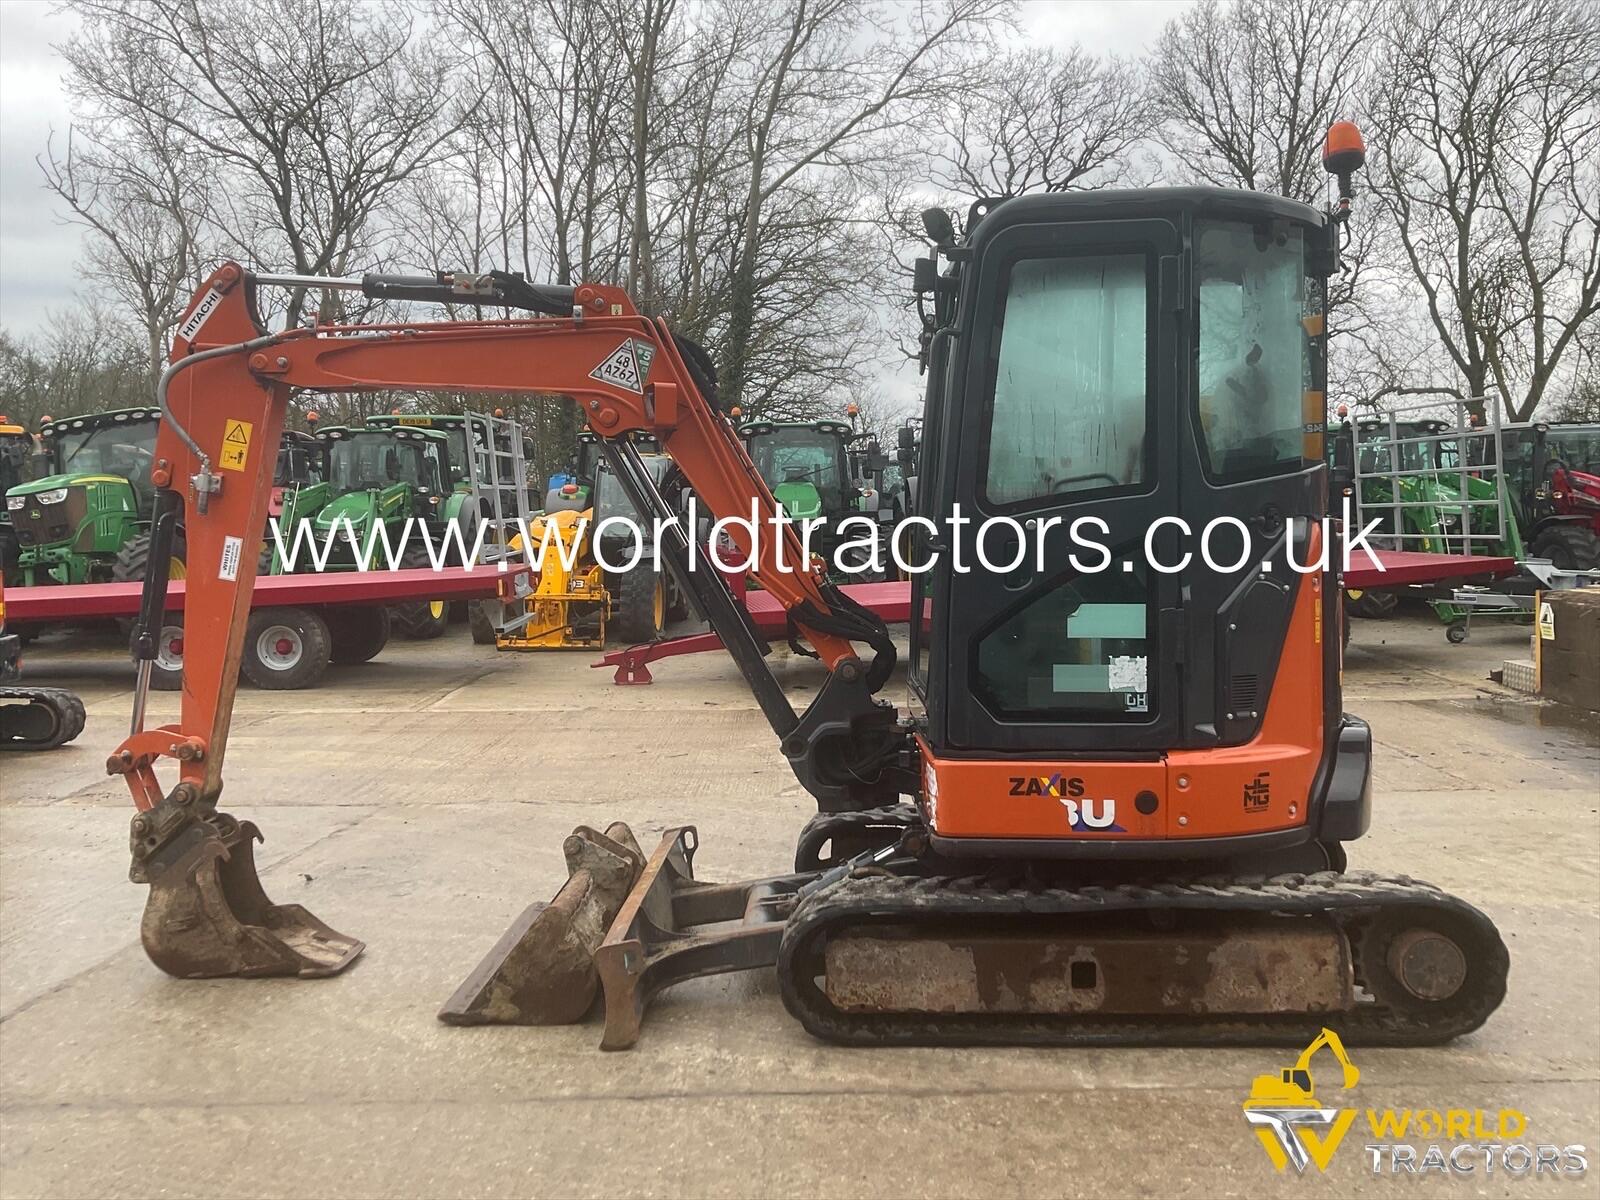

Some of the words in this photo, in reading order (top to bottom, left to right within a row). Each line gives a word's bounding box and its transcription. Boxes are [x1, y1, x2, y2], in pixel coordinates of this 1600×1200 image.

[182, 292, 219, 337] HITACHI
[616, 354, 631, 369] 48
[1009, 773, 1085, 797] ZAXIS
